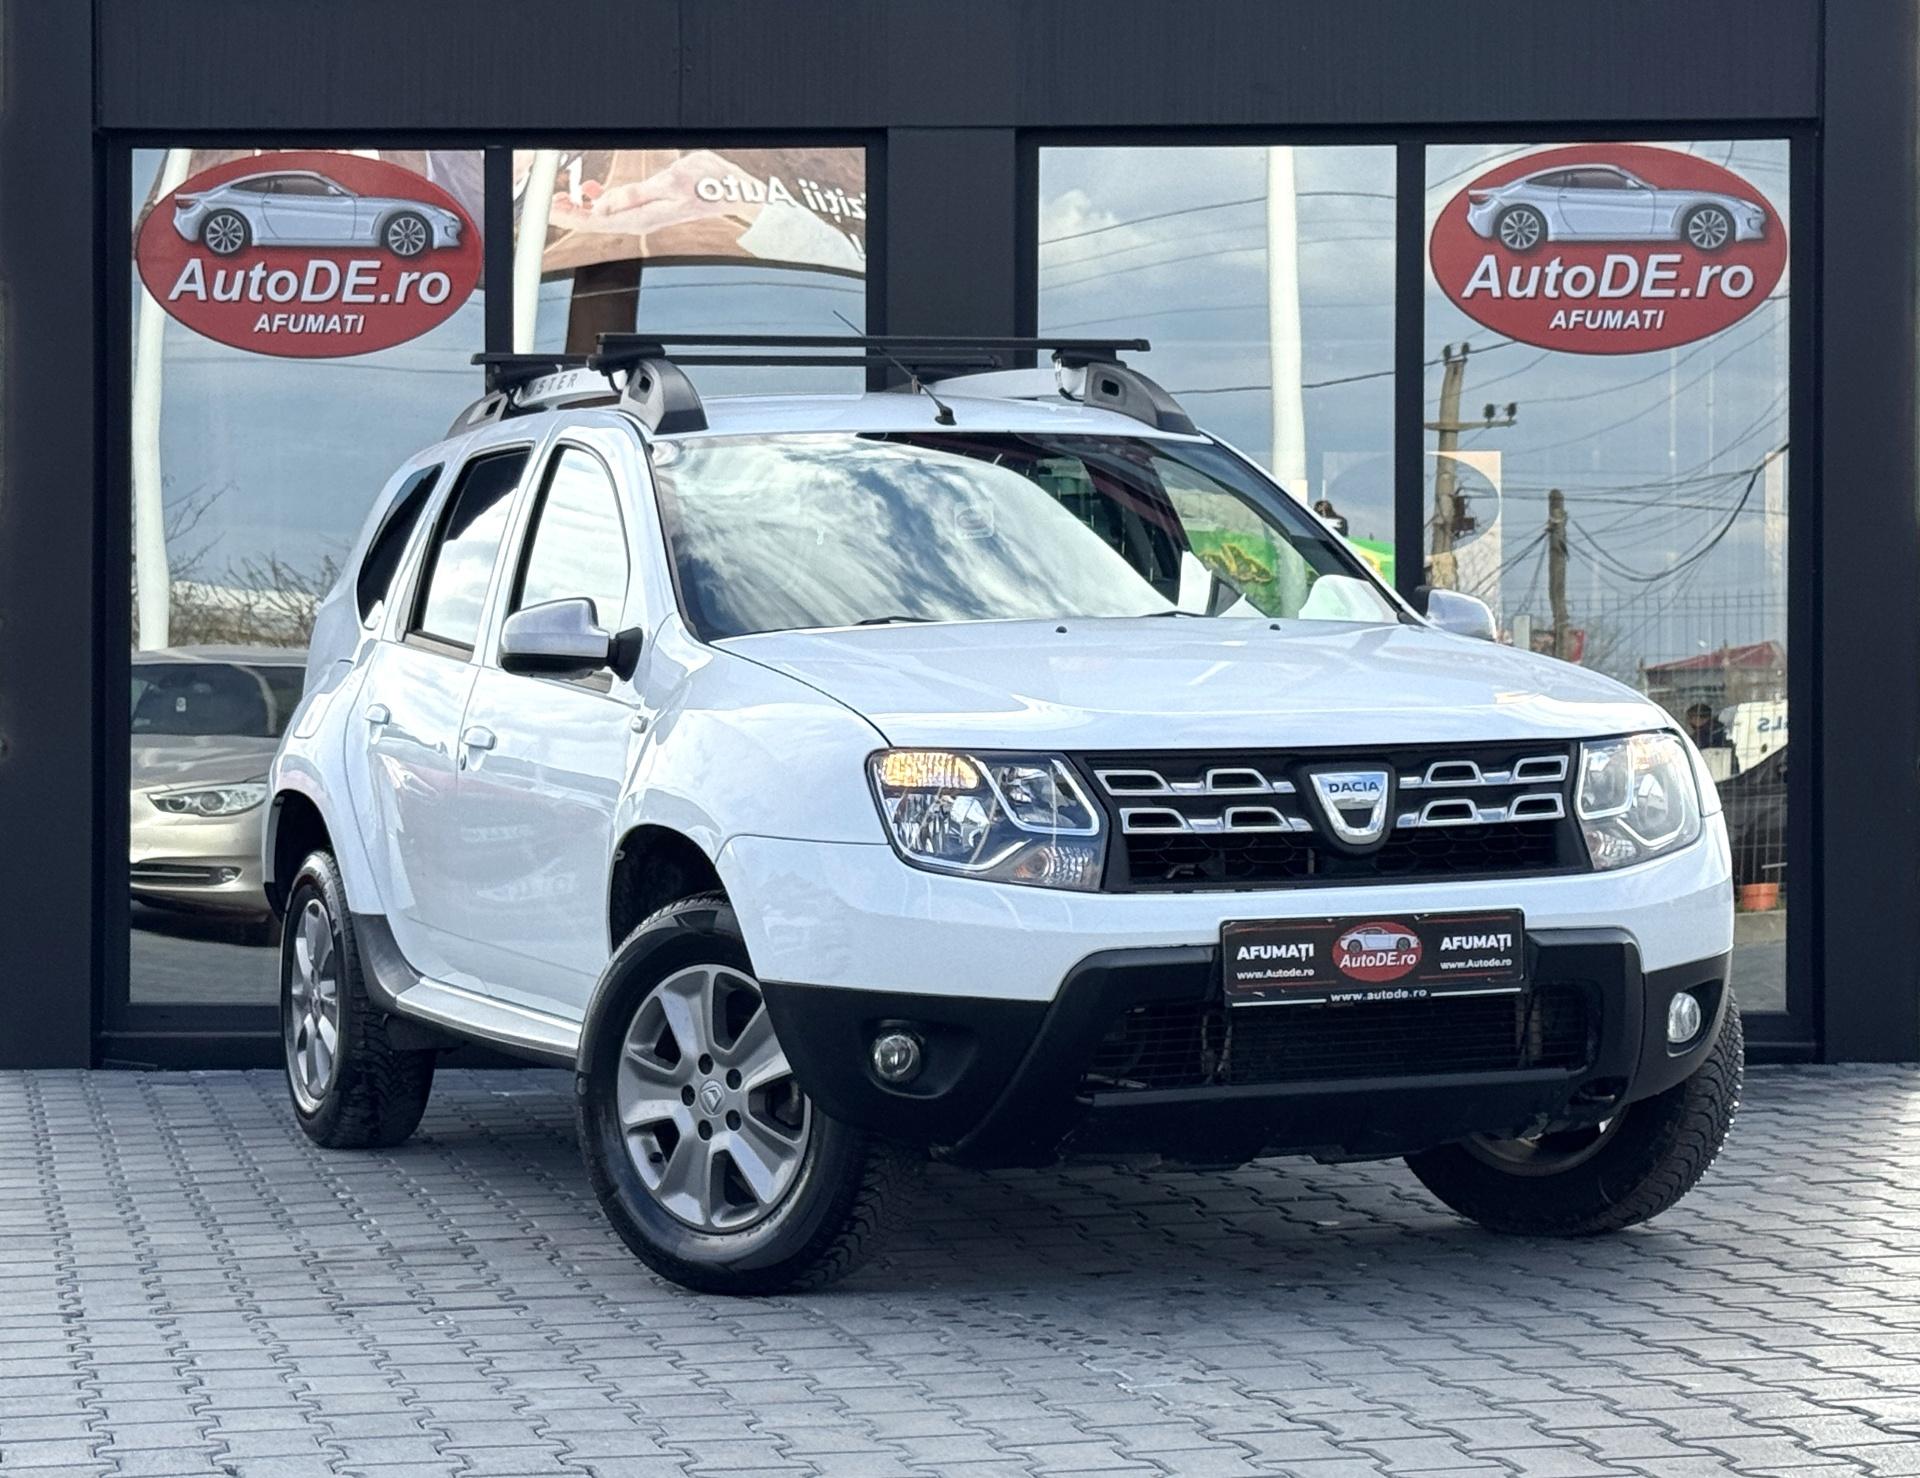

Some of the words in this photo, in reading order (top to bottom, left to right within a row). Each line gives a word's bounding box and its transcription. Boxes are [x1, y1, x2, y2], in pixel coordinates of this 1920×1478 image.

[168, 258, 452, 304] AutoDE.ro
[1461, 253, 1755, 300] AutoDE.ro
[253, 313, 365, 334] AFUMATI
[1549, 309, 1665, 330] AFUMATI
[1328, 781, 1380, 794] DACIA
[1339, 952, 1417, 969] AutoDE.ro
[1440, 957, 1512, 970] www.Autode.ro
[1236, 967, 1315, 980] www.Autode.ro
[1330, 988, 1428, 1002] www.autode.ro
